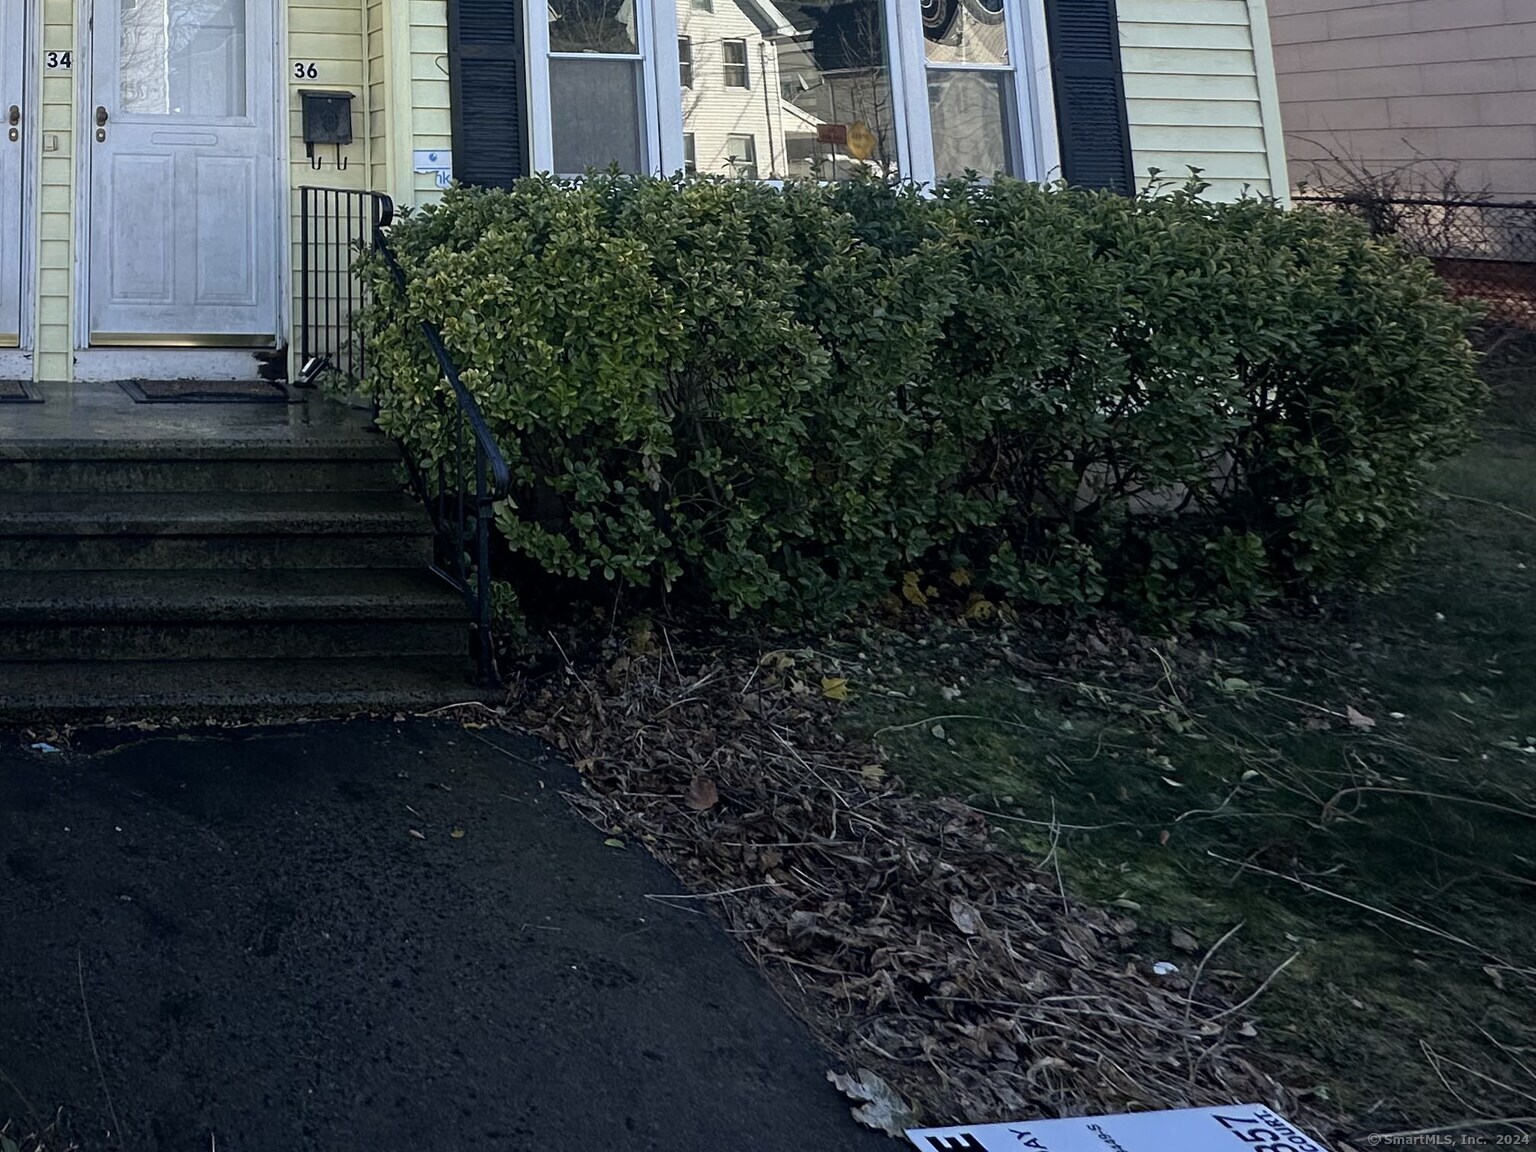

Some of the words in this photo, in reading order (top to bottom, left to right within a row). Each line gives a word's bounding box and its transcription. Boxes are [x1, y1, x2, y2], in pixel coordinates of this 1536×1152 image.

[47, 52, 71, 68] 34
[294, 62, 317, 78] 36
[1008, 1128, 1050, 1152] AY
